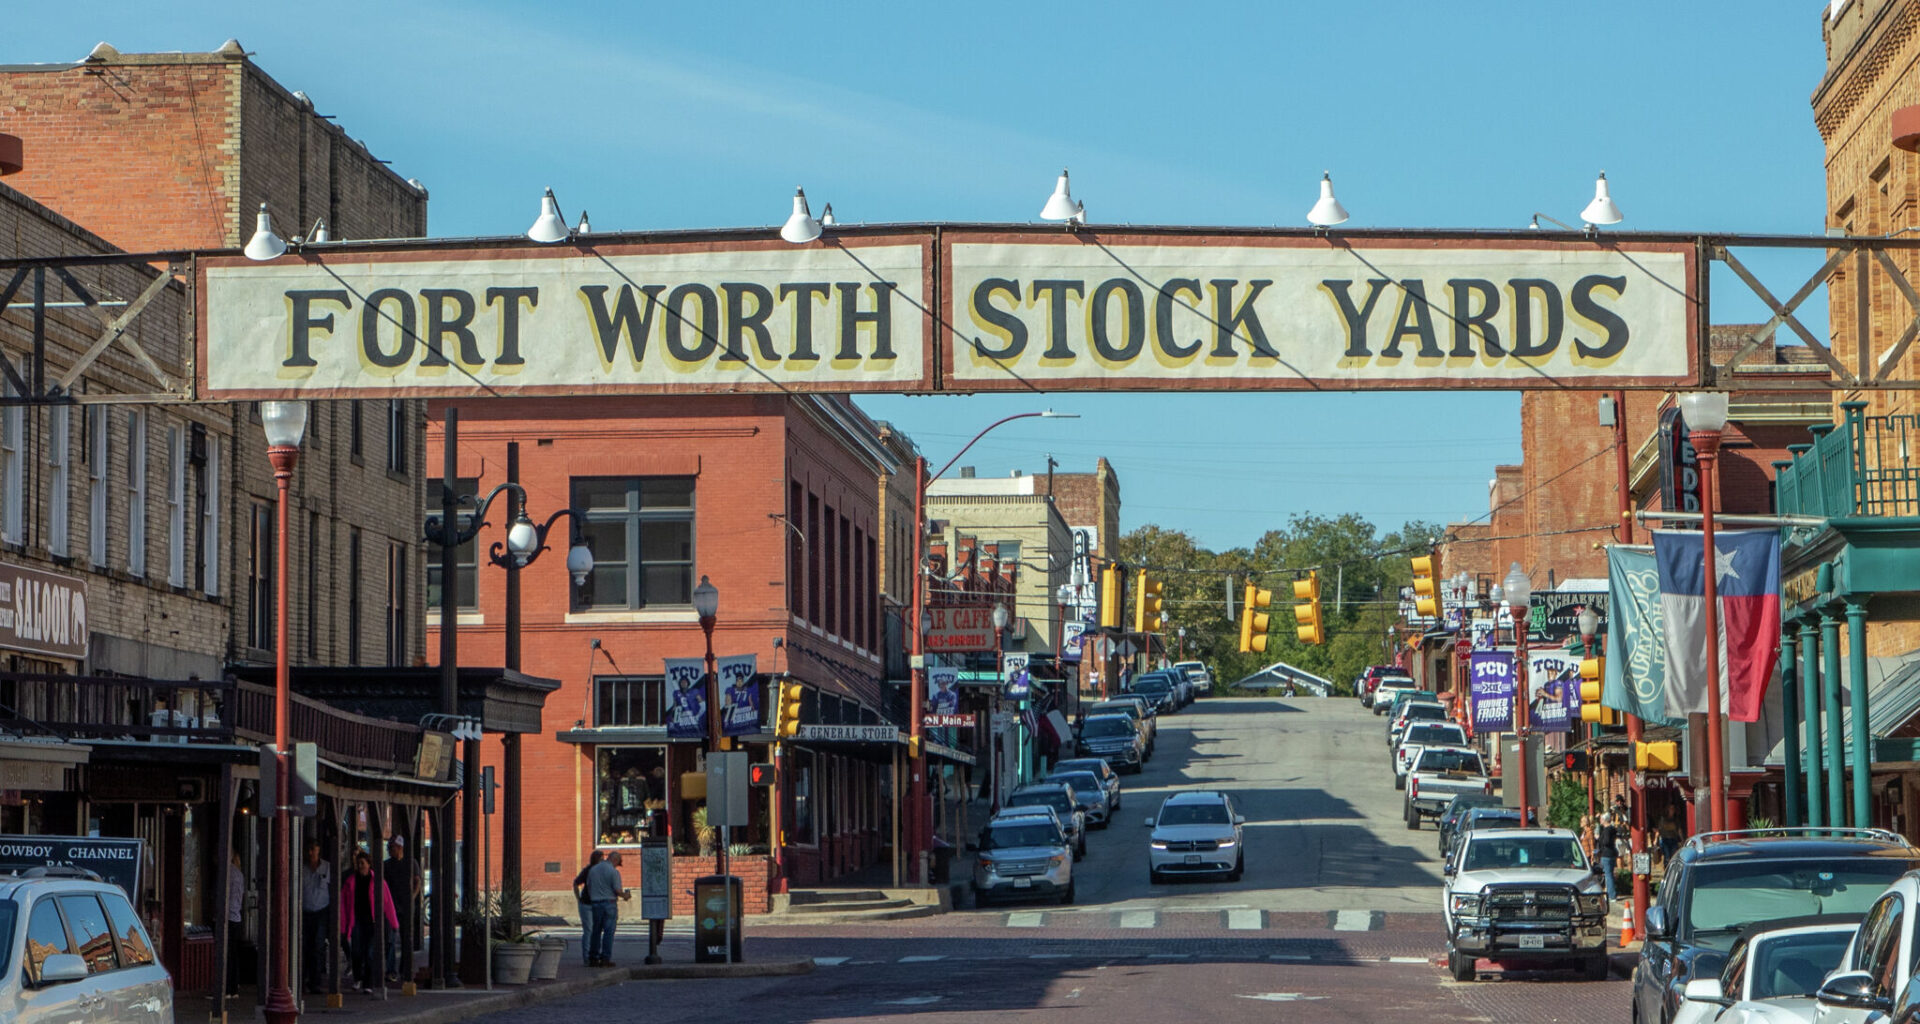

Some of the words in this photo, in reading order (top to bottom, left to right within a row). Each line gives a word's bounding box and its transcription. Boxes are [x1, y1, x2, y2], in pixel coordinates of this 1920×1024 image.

[280, 286, 539, 375] FORT
[579, 281, 899, 371] WORTH
[971, 276, 1281, 364] STOCK
[1321, 274, 1631, 364] YARDS
[15, 576, 70, 645] SALOON
[953, 608, 991, 630] CAFE
[1457, 646, 1473, 654] STOP
[1006, 658, 1025, 667] TCU
[1474, 661, 1508, 677] TCU
[1533, 659, 1565, 673] TCU
[670, 666, 700, 680] TCU
[722, 663, 753, 680] TCU
[932, 673, 955, 683] TCU
[1476, 706, 1509, 719] FROGS
[933, 716, 939, 725] N
[942, 716, 962, 725] Main
[810, 726, 858, 738] GENERAL
[861, 726, 894, 738] STORE
[0, 844, 53, 857] OWBOY
[68, 847, 134, 859] CHANNEL
